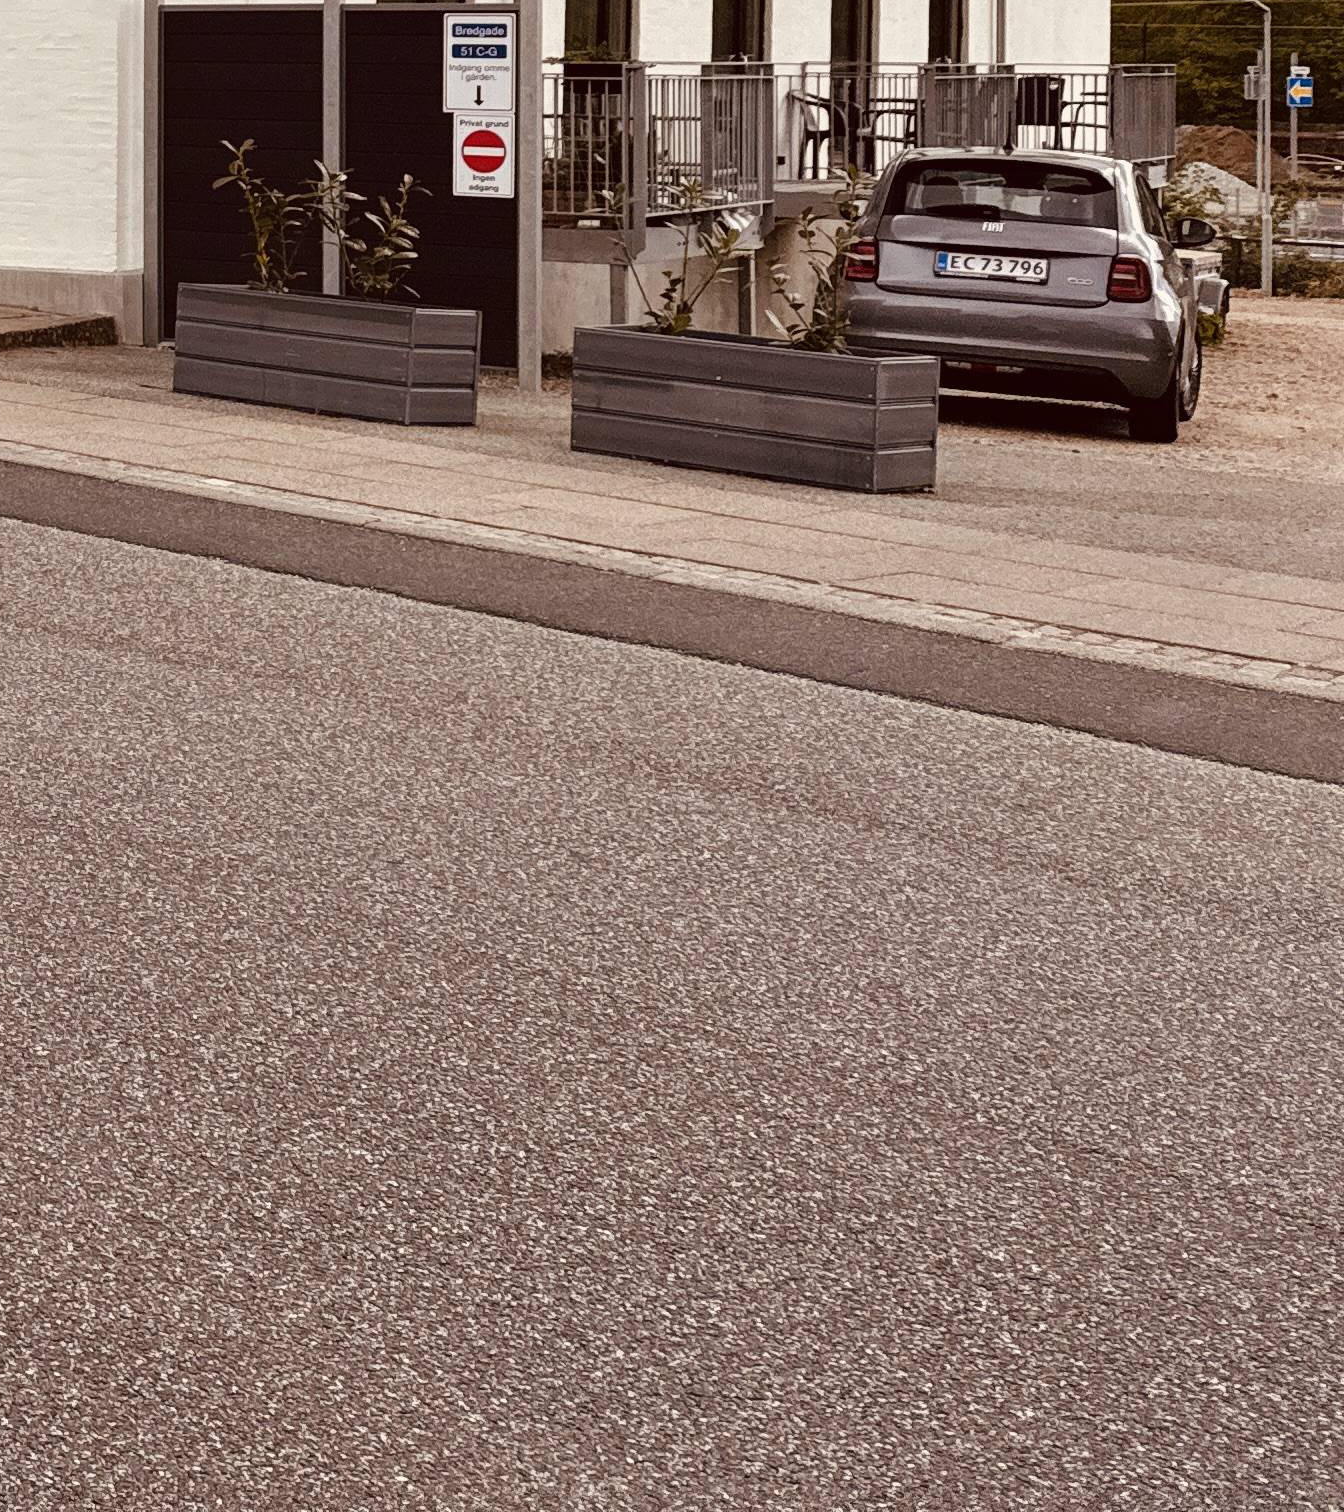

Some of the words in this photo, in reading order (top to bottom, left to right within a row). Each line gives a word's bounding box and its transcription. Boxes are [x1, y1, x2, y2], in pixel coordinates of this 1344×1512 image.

[455, 26, 505, 37] Bredgade
[460, 46, 472, 56] 51
[476, 46, 498, 56] C-G
[950, 255, 976, 270] EC
[980, 257, 1004, 272] 73
[1008, 259, 1044, 275] 796
